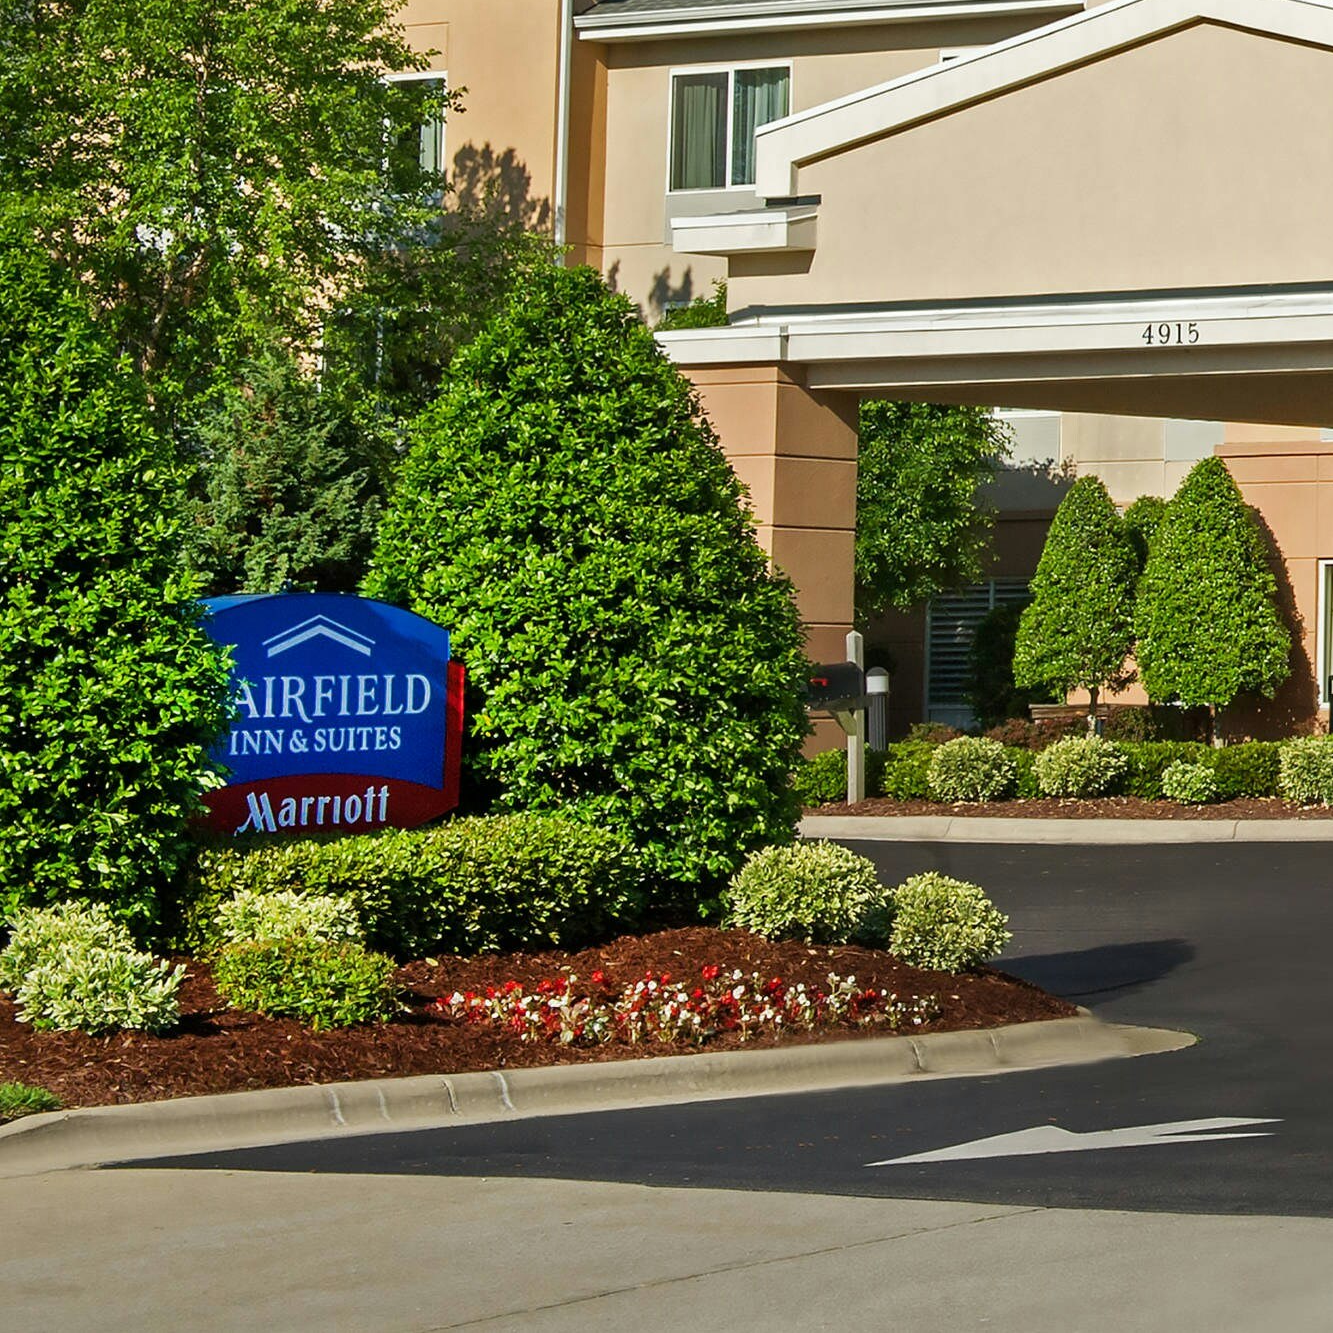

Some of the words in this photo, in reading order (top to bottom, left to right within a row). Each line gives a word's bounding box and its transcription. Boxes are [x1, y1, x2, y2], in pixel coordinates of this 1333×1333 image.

[1142, 322, 1200, 345] 4915
[234, 674, 432, 724] AIRFIELD
[229, 729, 284, 756] INN
[289, 729, 308, 754] &
[313, 725, 402, 753] SUITES
[234, 785, 390, 838] Marriott
